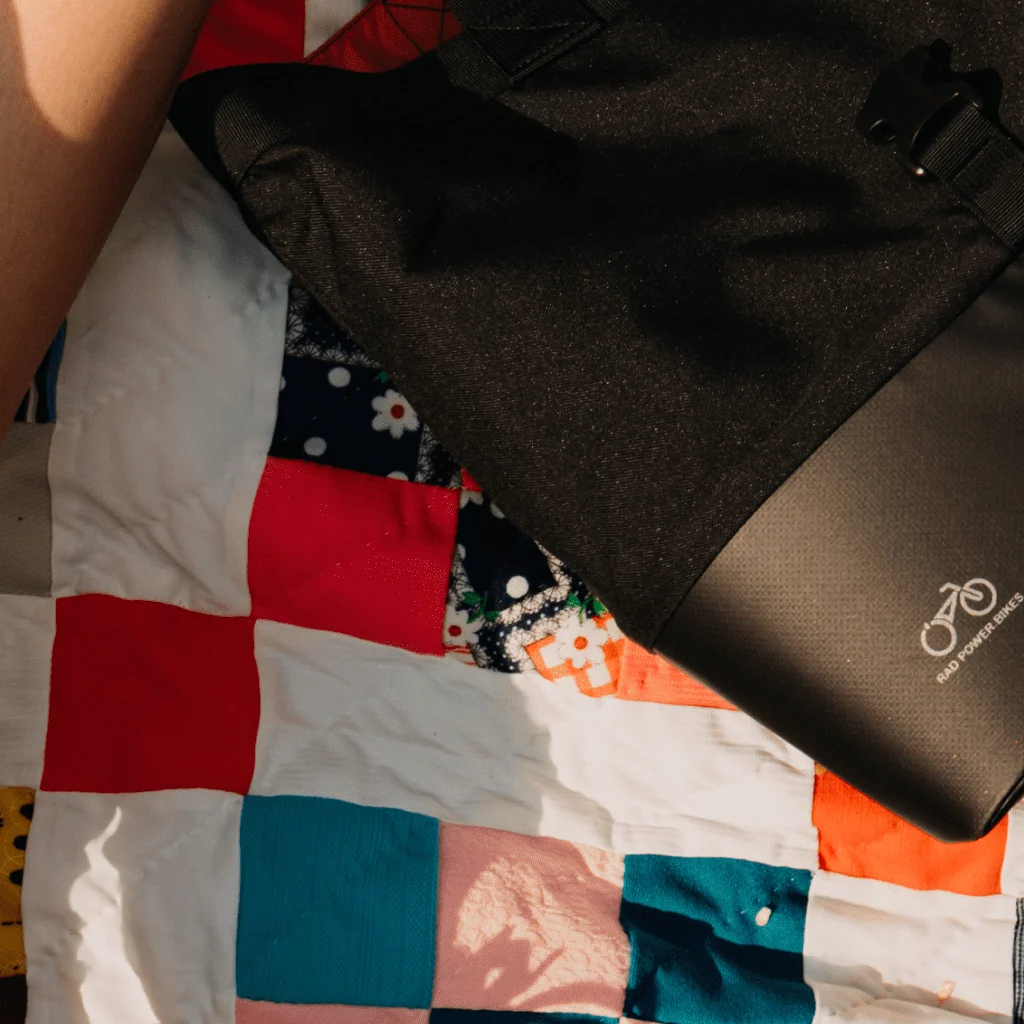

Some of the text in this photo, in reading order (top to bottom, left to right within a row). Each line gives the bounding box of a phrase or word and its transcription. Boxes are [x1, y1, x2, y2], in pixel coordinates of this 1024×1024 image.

[936, 592, 1024, 685] RAD POWER BIKES
